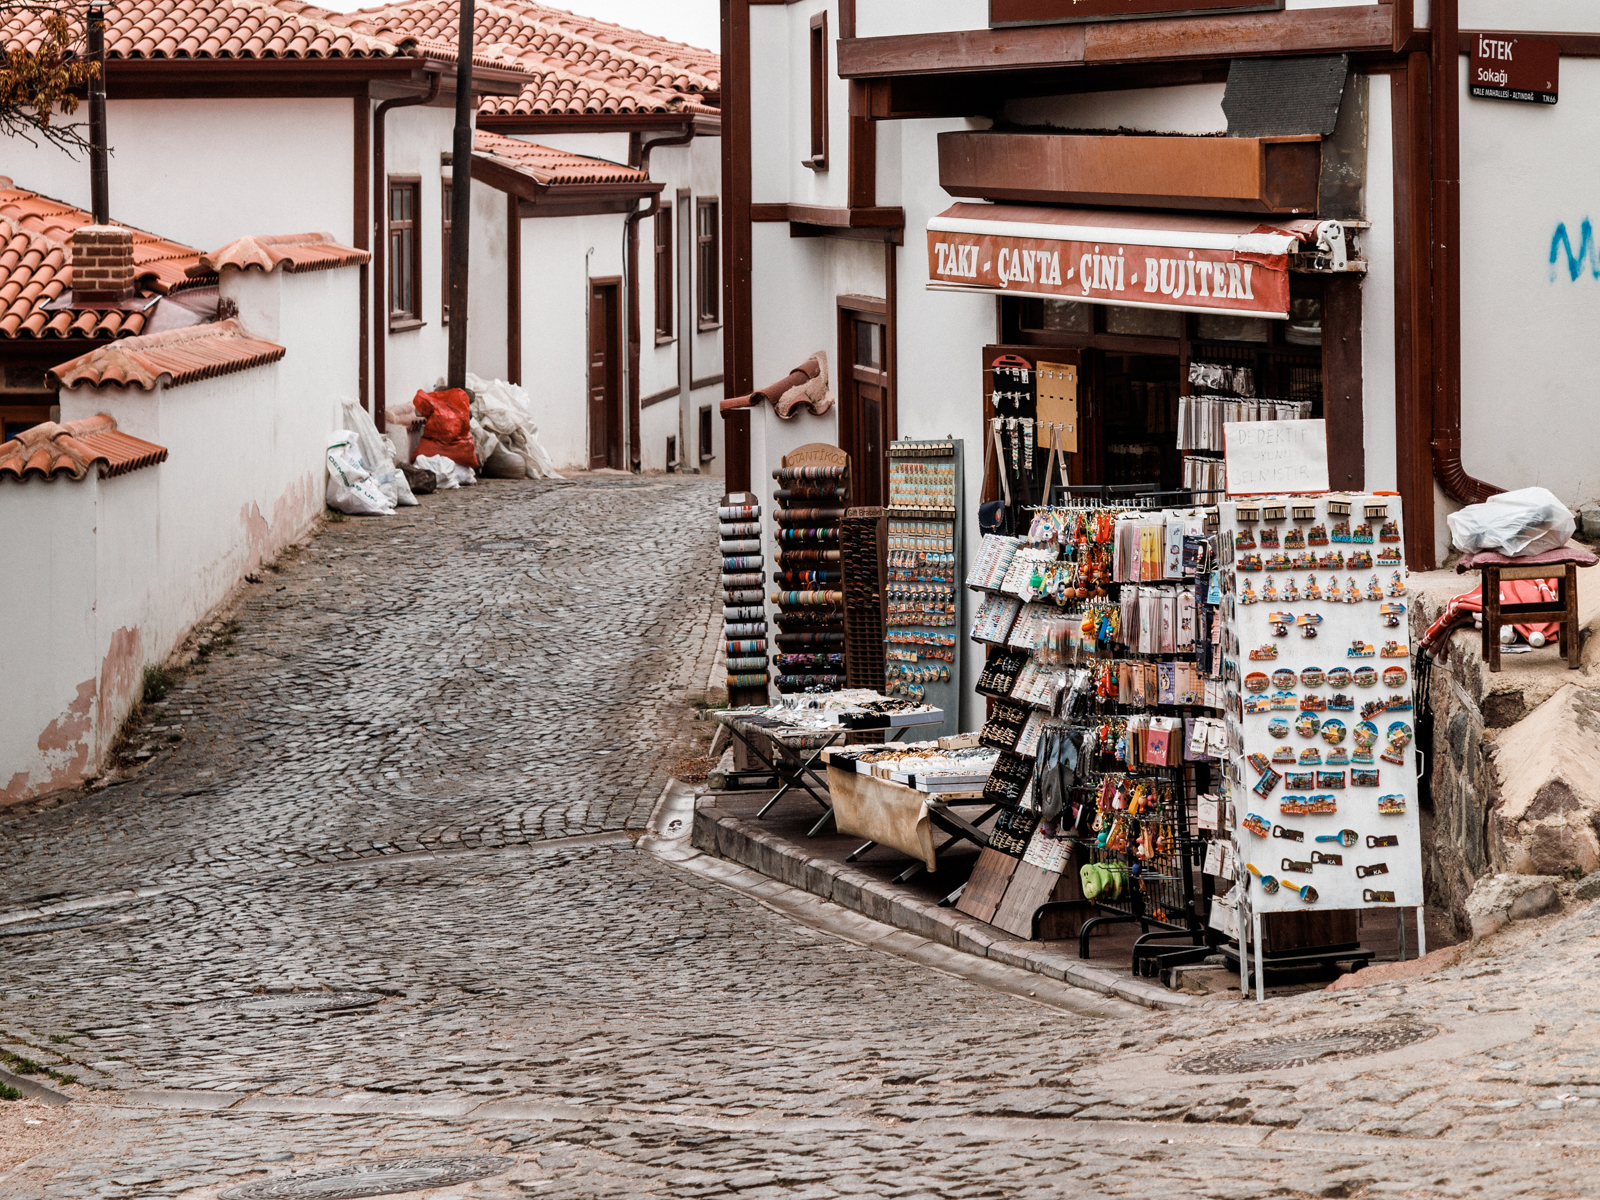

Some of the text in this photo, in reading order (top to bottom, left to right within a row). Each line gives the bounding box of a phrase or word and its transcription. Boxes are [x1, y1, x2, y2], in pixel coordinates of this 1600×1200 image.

[1478, 33, 1513, 61] İSTEK
[1477, 67, 1508, 87] Sokağı
[934, 242, 980, 278] TAKI
[998, 247, 1062, 288] ÇANTA
[1080, 245, 1125, 296] ÇİNİ
[847, 507, 858, 517] Gift
